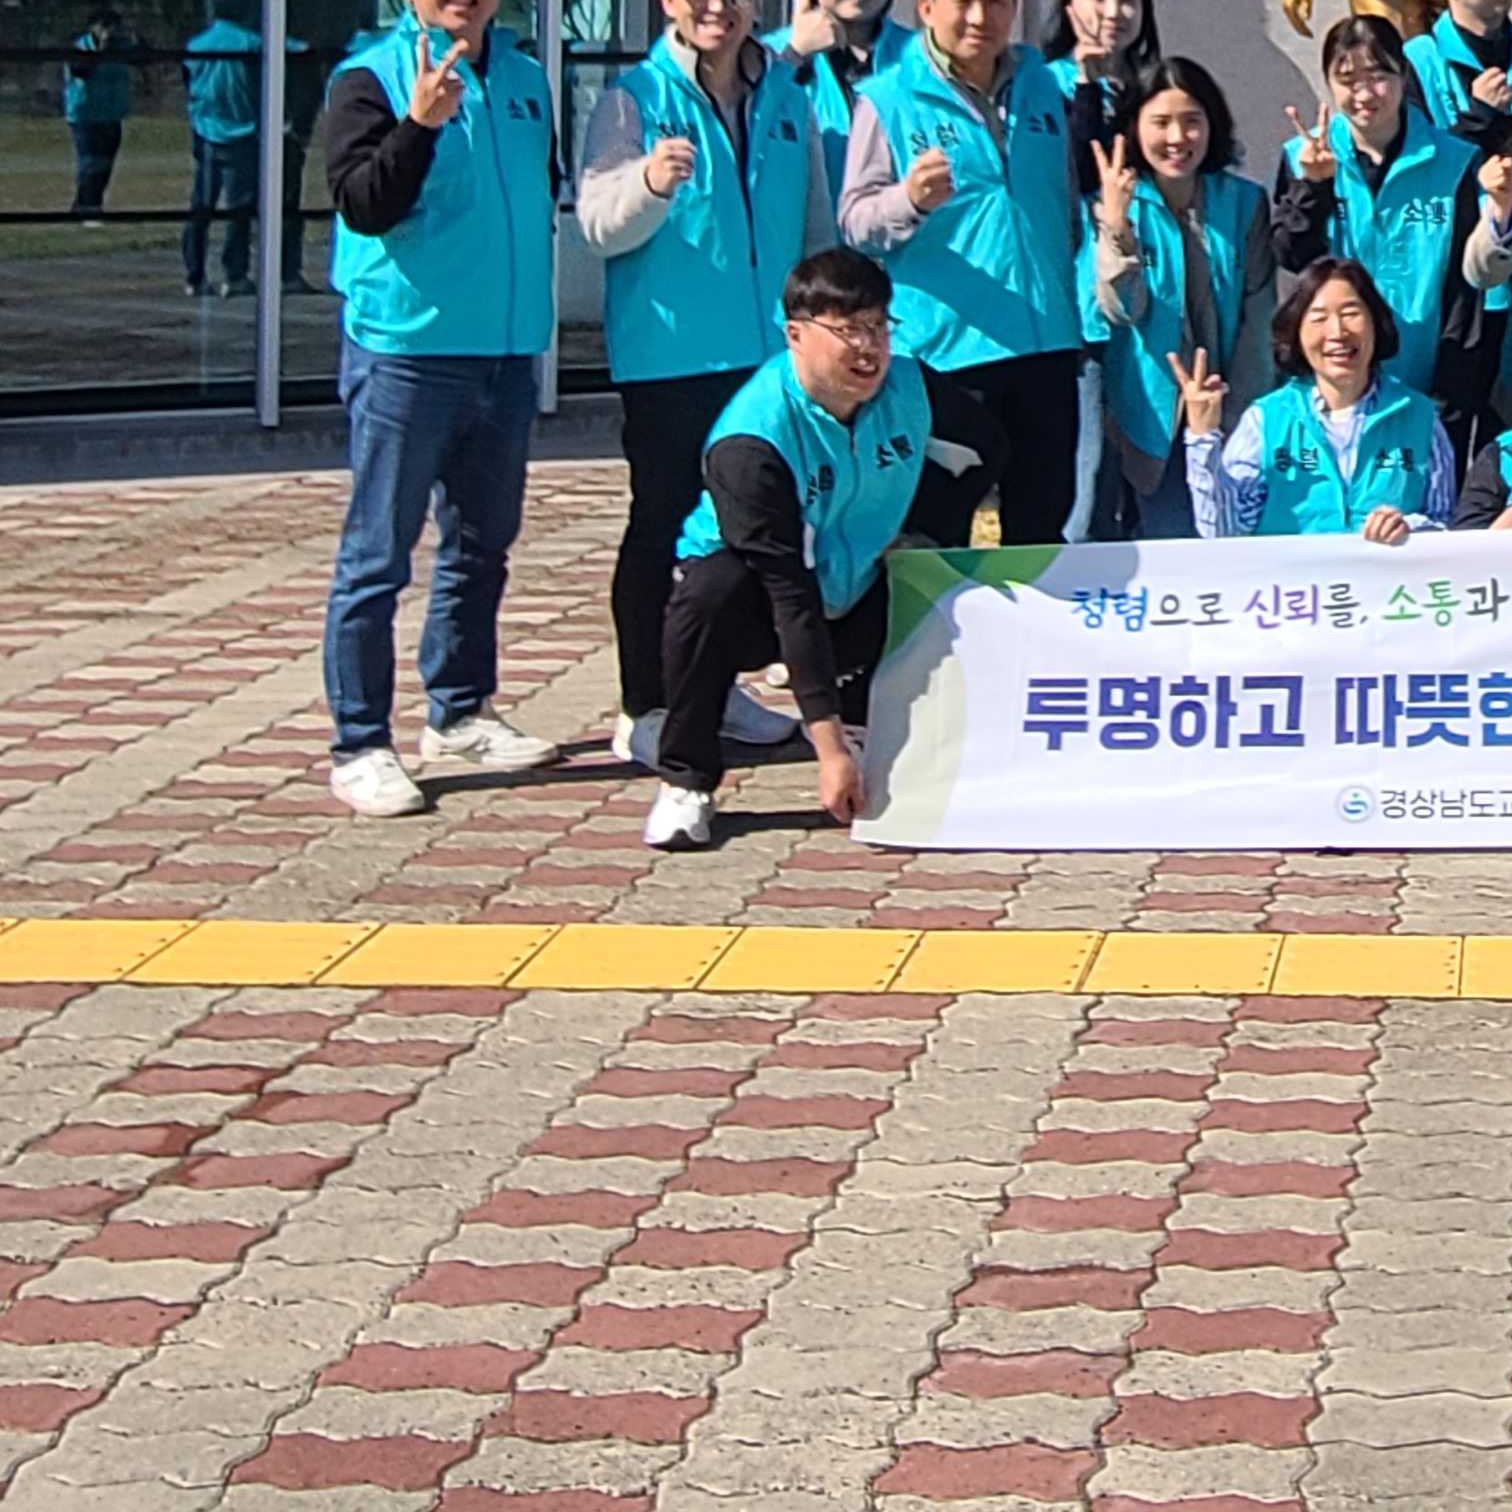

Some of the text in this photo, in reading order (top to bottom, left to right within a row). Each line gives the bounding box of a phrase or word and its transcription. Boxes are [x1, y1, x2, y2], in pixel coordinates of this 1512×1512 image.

[1070, 585, 1230, 631] 청렴으로
[1246, 584, 1368, 629] 신뢰를,
[1382, 577, 1510, 626] 소통과
[1023, 675, 1305, 750] 투명하고
